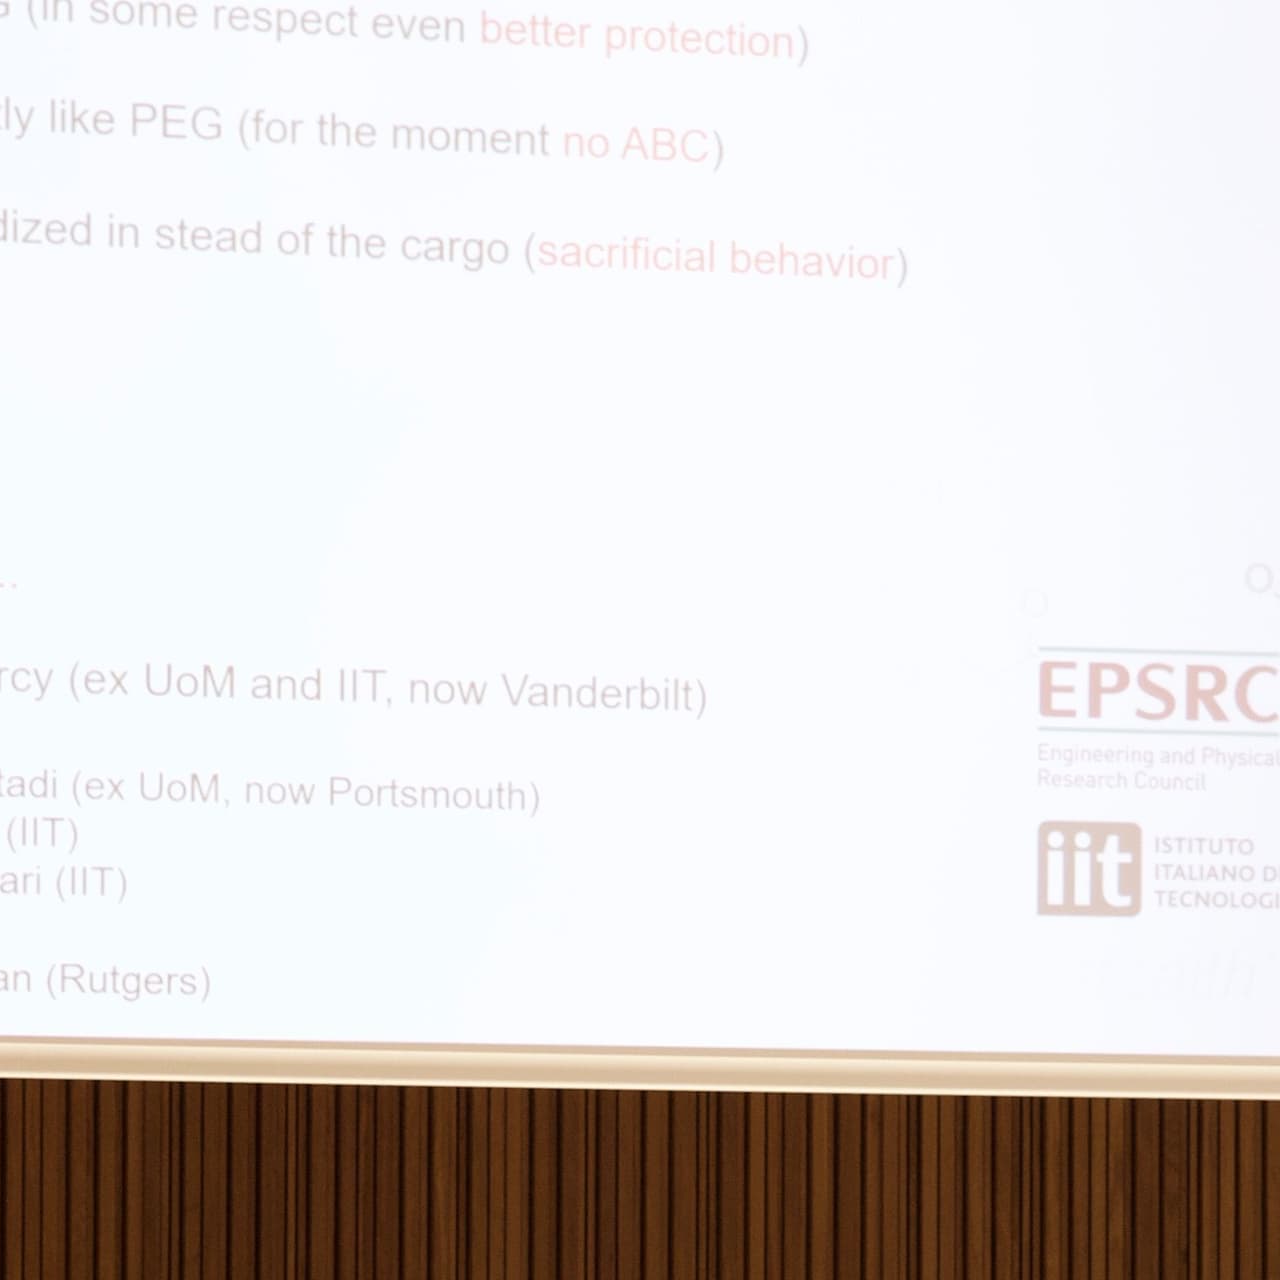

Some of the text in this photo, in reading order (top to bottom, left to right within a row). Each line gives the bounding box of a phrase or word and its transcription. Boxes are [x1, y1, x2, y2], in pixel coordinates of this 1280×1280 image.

[89, 0, 199, 30] some
[213, 4, 359, 43] respect
[371, 13, 465, 43] even
[480, 9, 592, 49] better
[605, 21, 809, 68] protection)
[50, 98, 115, 136] like
[131, 101, 223, 141] PEG
[238, 108, 305, 151] (for
[316, 111, 378, 150] the
[392, 124, 550, 157] moment
[563, 131, 611, 159] no
[620, 126, 725, 172] ABC)
[107, 212, 140, 249] in
[155, 218, 262, 254] stead
[276, 221, 316, 257] of
[326, 223, 387, 260] the
[400, 235, 510, 273] cargo
[523, 231, 716, 275] (sacrificial
[730, 239, 908, 289] behavior)
[69, 661, 129, 703] (ex
[145, 663, 235, 699] UoM
[250, 667, 322, 701] and
[339, 667, 393, 707] IIT,
[409, 679, 488, 706] now
[500, 672, 707, 720] Vanderbilt)
[1038, 660, 1280, 724] EPSRC
[1037, 741, 1156, 771] Engineering
[1158, 745, 1198, 769] and
[72, 770, 125, 807] (ex
[139, 771, 230, 807] UoM,
[245, 781, 316, 806] now
[329, 775, 540, 817] Portsmouth)
[1036, 766, 1208, 793] Research Council
[6, 815, 78, 854] (IIT)
[1154, 835, 1255, 856] ISTITUTO
[55, 865, 127, 905] (IIT)
[1047, 830, 1133, 907] iit
[1154, 863, 1256, 883] ITALIANO
[46, 962, 211, 1003] (Rutgers)
